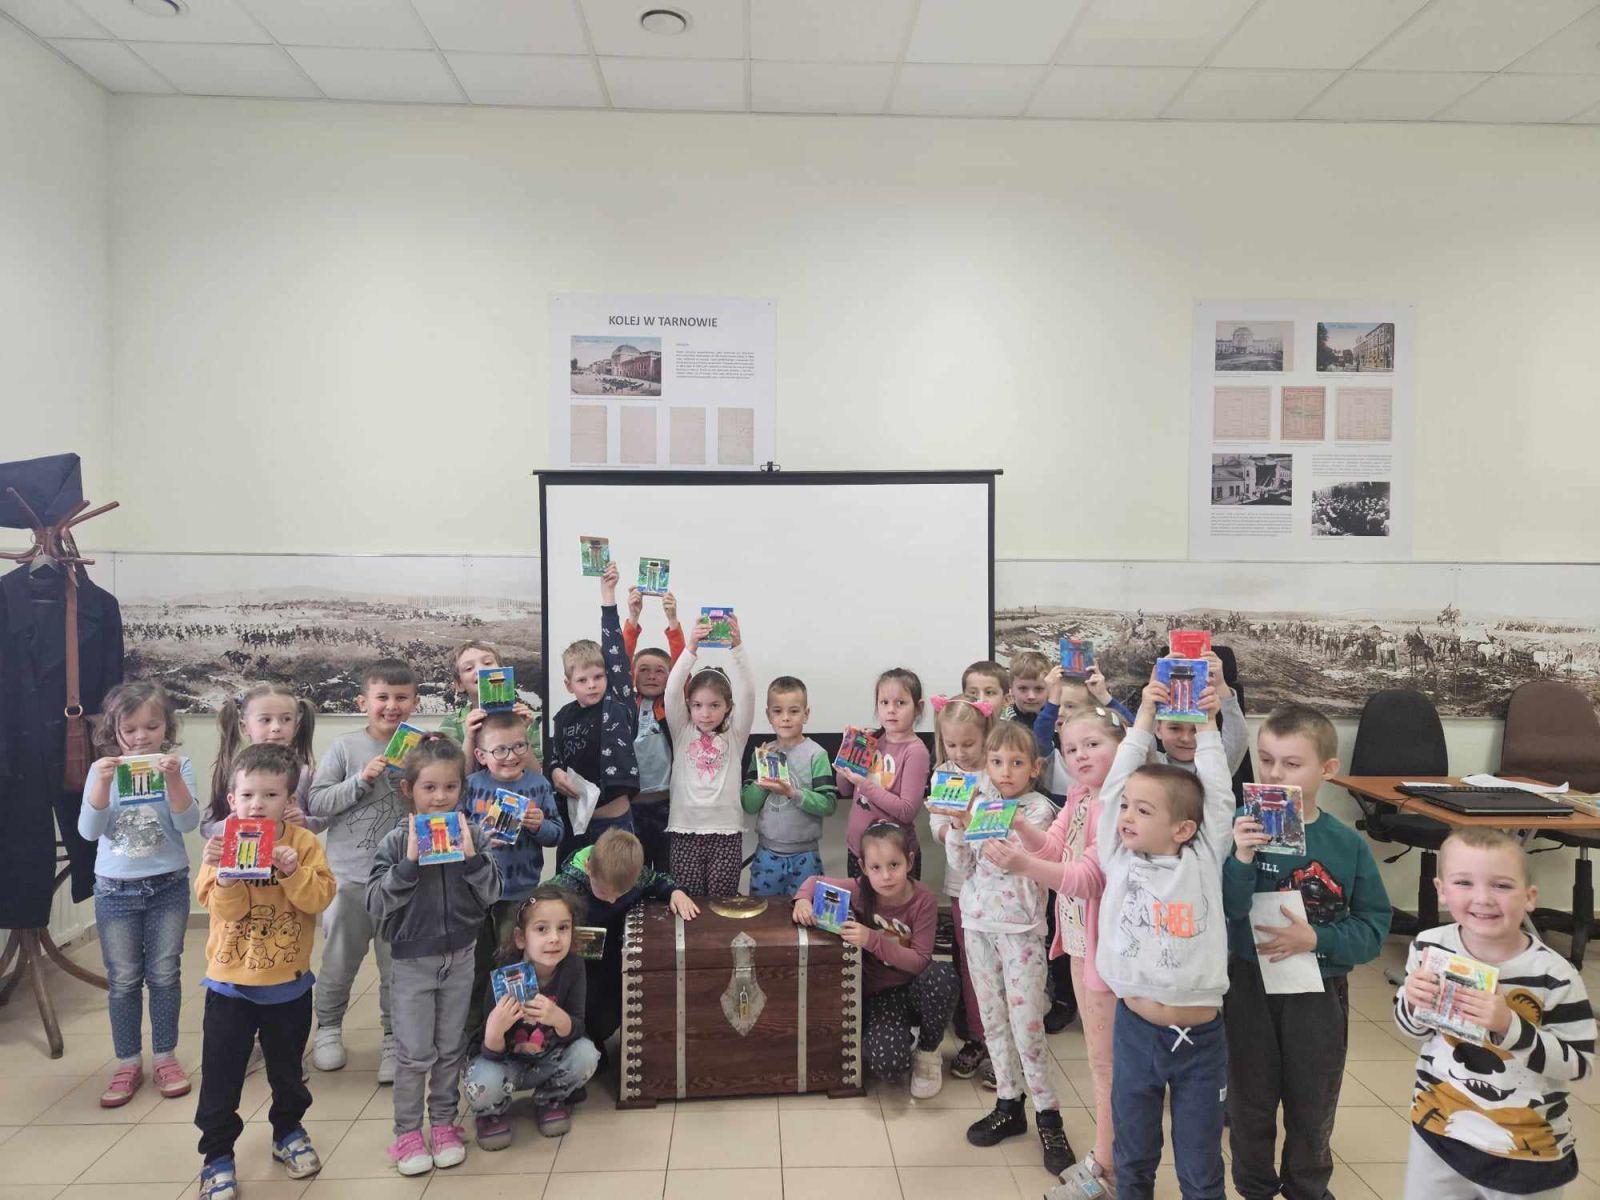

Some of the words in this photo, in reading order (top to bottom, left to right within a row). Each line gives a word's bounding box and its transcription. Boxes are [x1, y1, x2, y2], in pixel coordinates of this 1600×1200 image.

[608, 315, 640, 326] KOLEJ
[643, 316, 656, 326] W
[658, 316, 718, 328] TARNOWIE
